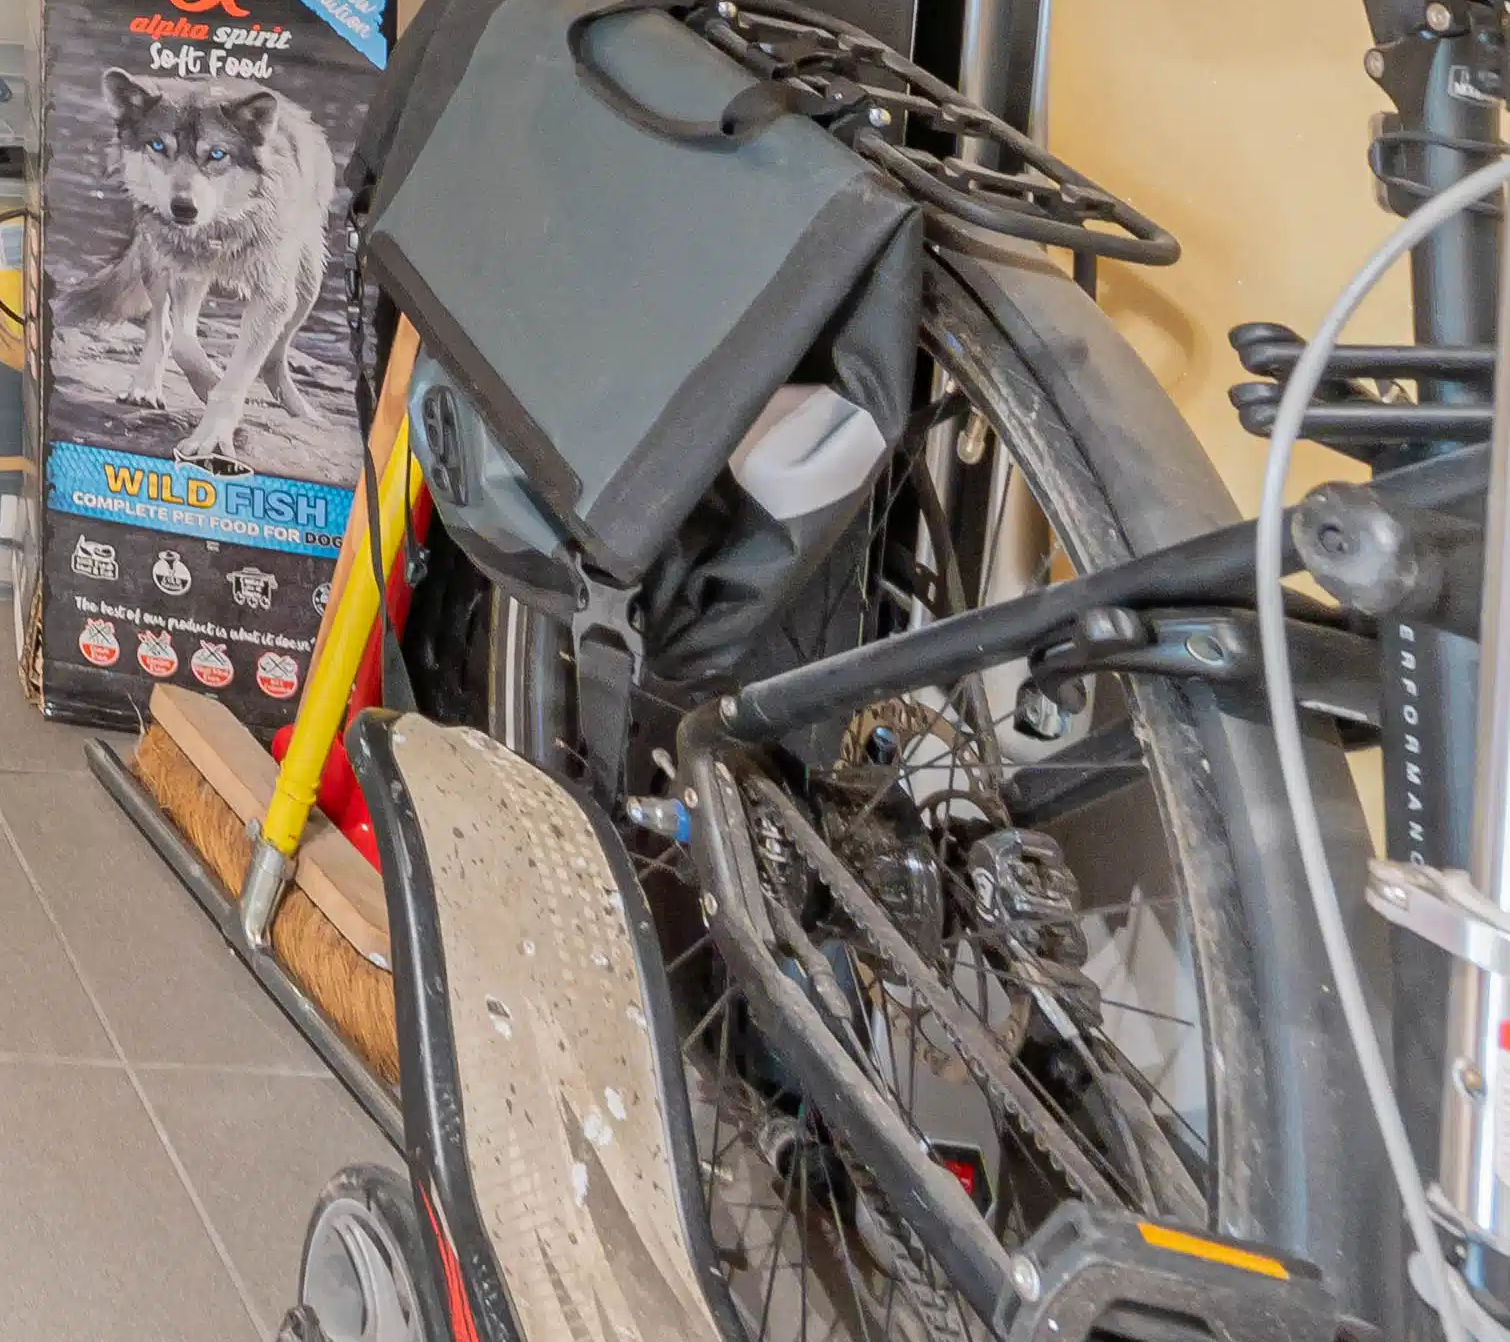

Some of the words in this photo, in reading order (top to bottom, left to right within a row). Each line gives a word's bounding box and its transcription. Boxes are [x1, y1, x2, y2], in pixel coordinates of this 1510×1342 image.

[128, 14, 209, 40] alpha
[213, 22, 293, 50] spirit
[149, 41, 205, 79] Soft
[208, 48, 274, 80] Food
[72, 491, 169, 522] COMPLETE
[172, 508, 205, 528] PET
[209, 515, 261, 537] FOOD
[263, 524, 301, 544] FOR
[305, 531, 345, 549] DOG
[104, 463, 217, 509] WILD
[224, 482, 328, 528] FISH
[74, 595, 99, 614] The
[100, 601, 127, 620] best
[167, 617, 215, 636] product
[275, 634, 317, 652] doesn'
[1399, 624, 1425, 867] ERFORMANC
